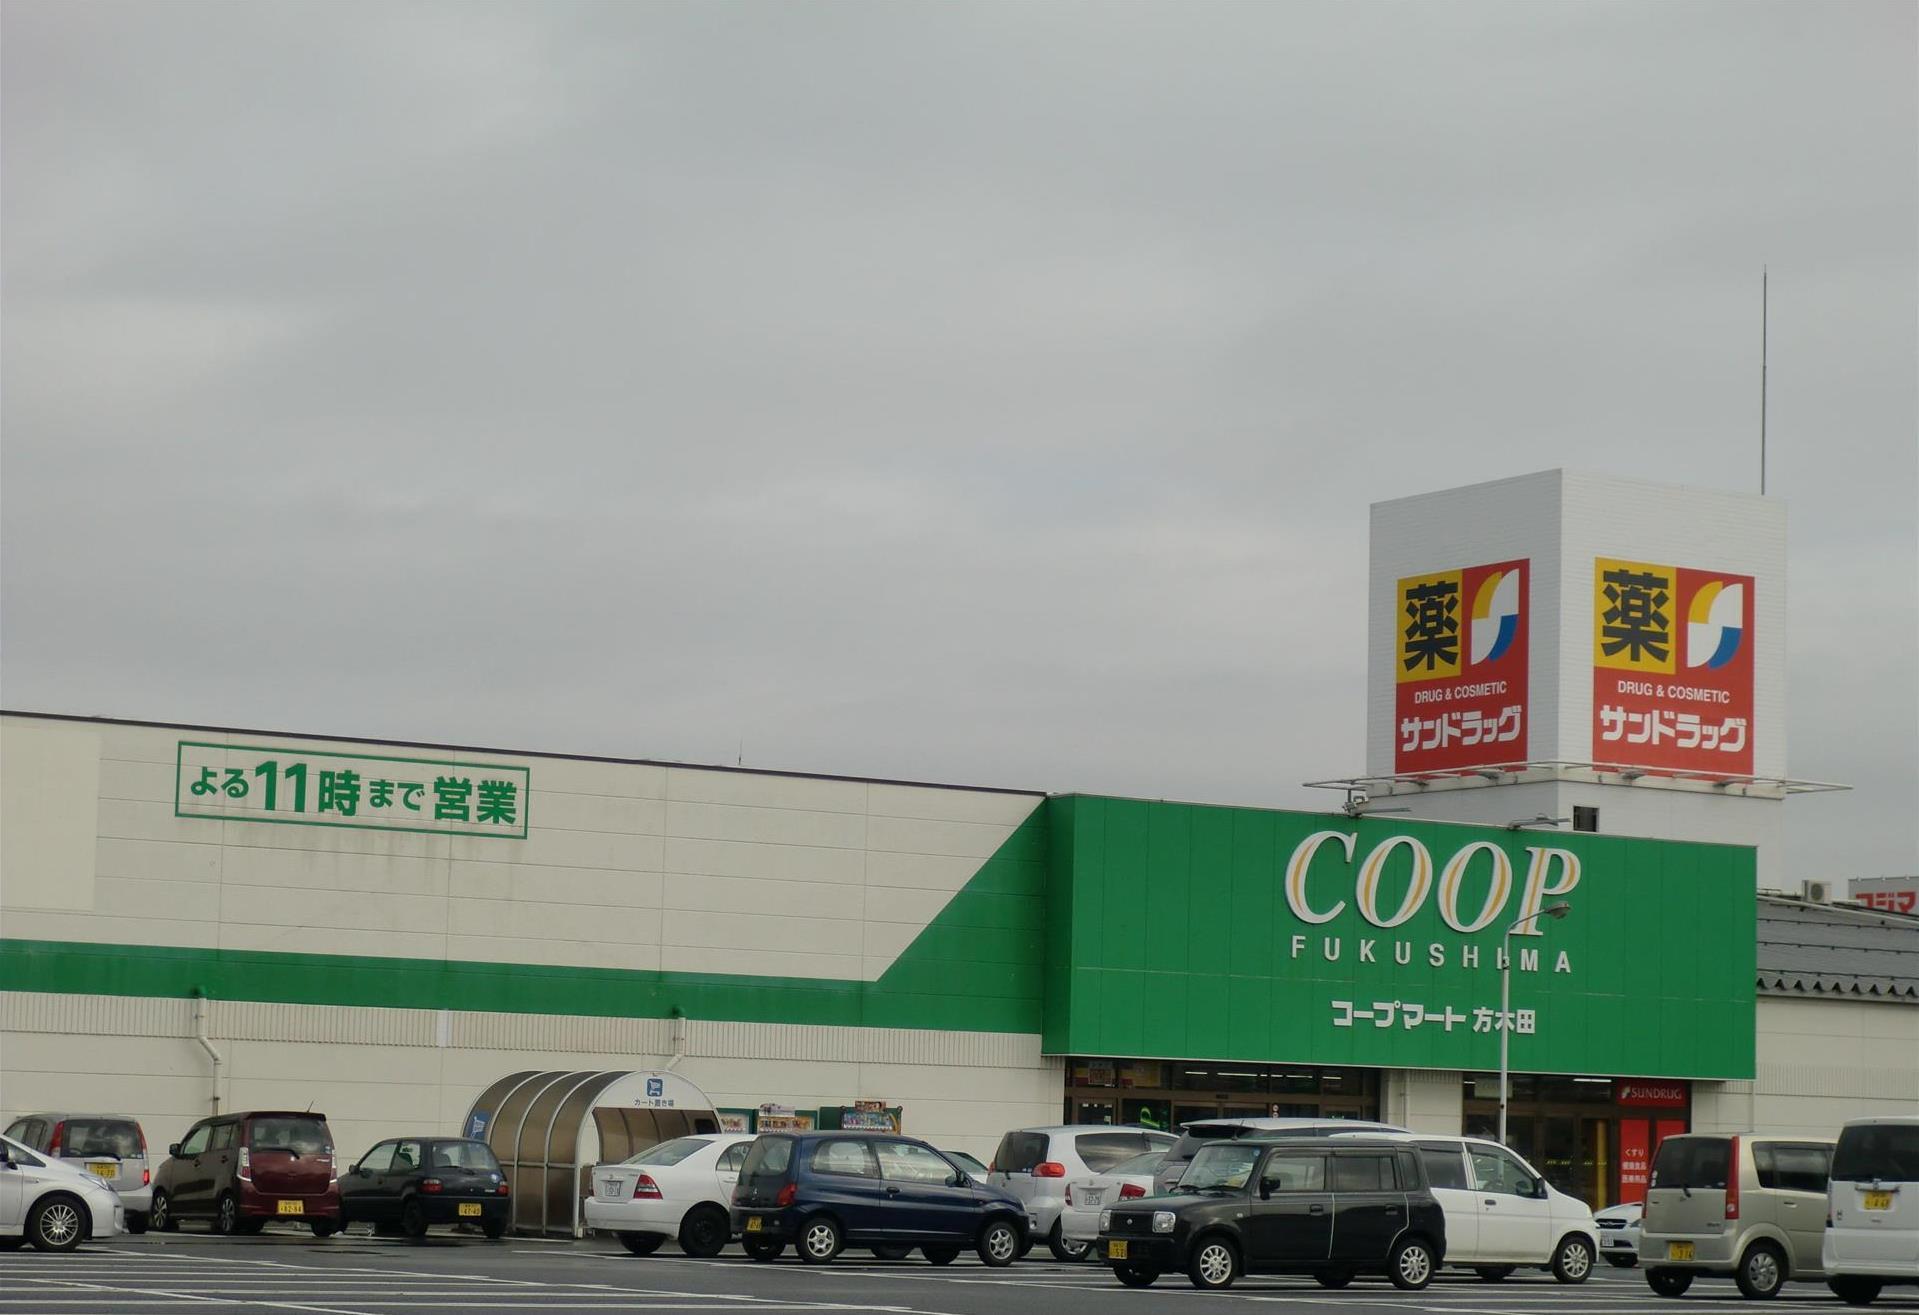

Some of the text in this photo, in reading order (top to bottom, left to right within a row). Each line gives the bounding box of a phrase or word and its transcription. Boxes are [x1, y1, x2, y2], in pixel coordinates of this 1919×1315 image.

[1404, 580, 1459, 672] 薬
[1602, 568, 1670, 663] 薬
[1414, 680, 1507, 704] DRUG & COSMETIC
[1617, 680, 1730, 704] DRUG & COSMETIC
[1400, 704, 1522, 753] サンドラッグ
[1600, 704, 1747, 753] サンドラッグ
[1285, 830, 1581, 936] COOP
[1291, 935, 1571, 974] FUKUSHIMA
[1631, 1087, 1682, 1099] SUNDRUG
